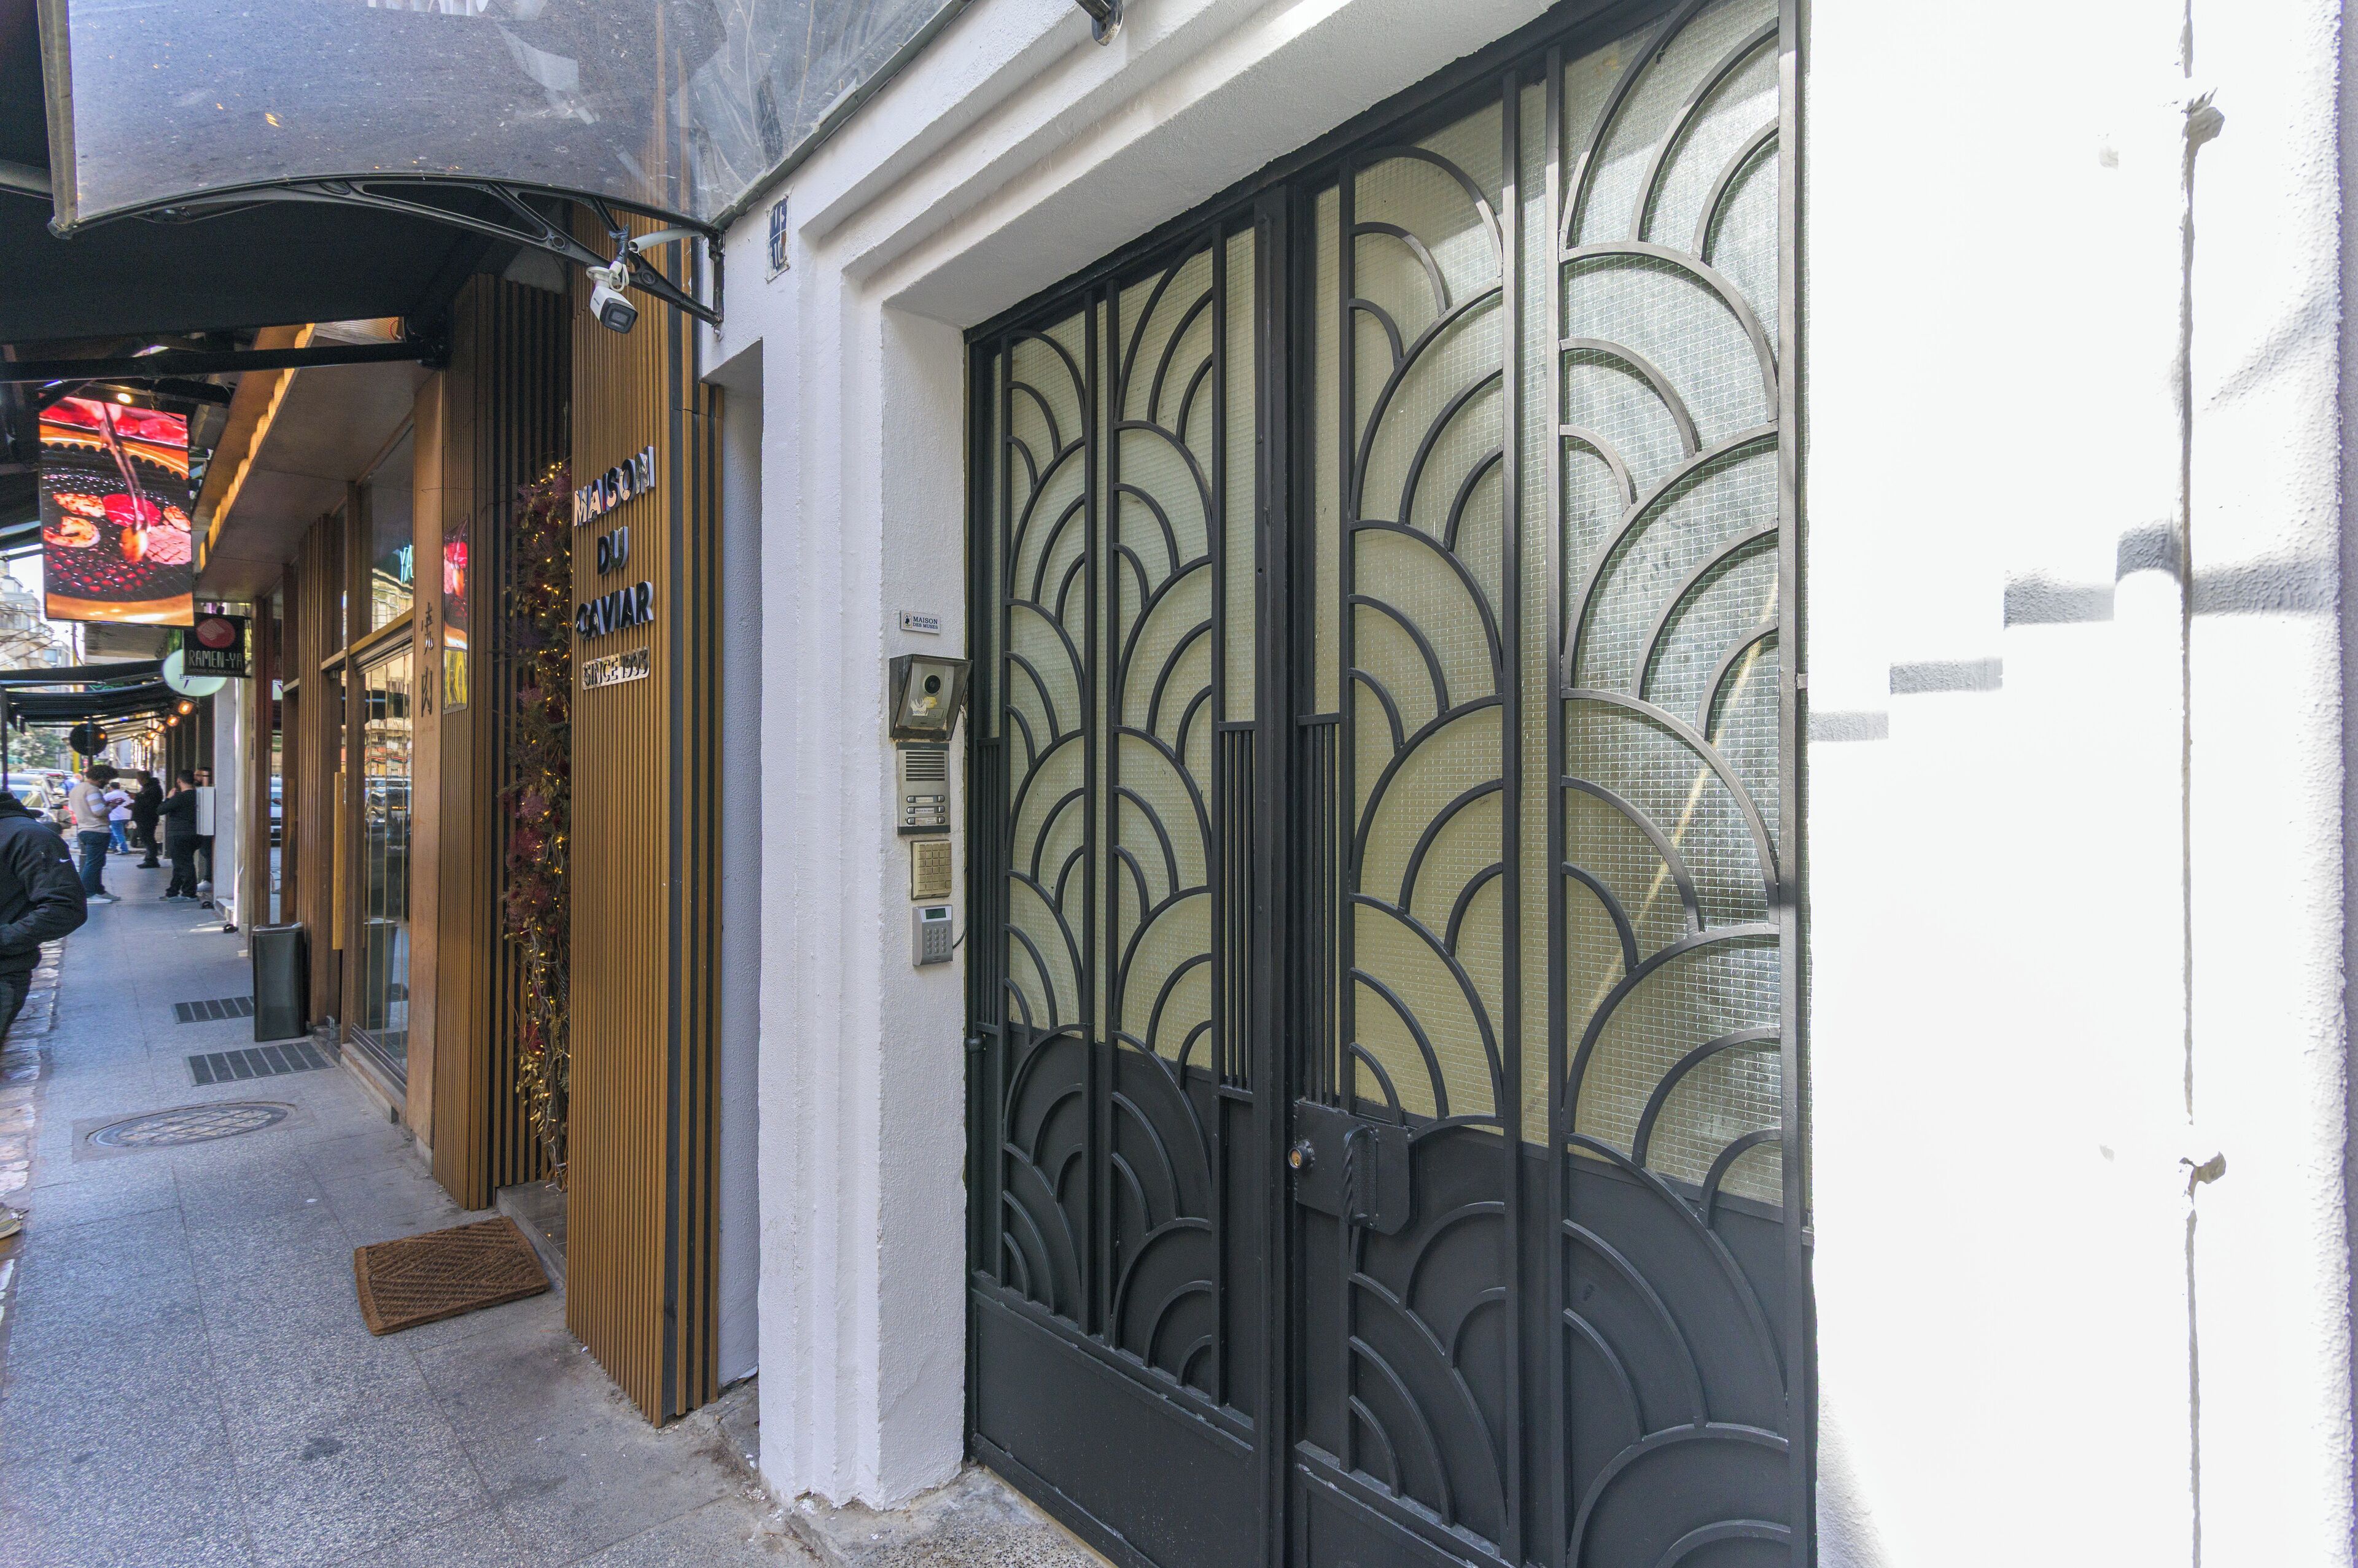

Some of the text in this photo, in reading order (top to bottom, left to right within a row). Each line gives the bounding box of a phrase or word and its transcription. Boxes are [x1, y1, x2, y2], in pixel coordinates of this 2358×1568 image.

[574, 446, 655, 527] MAISON
[597, 526, 628, 576] DU
[576, 581, 654, 641] CAVIAR
[189, 650, 243, 669] RAMEN-YA
[583, 657, 618, 686] SINCE
